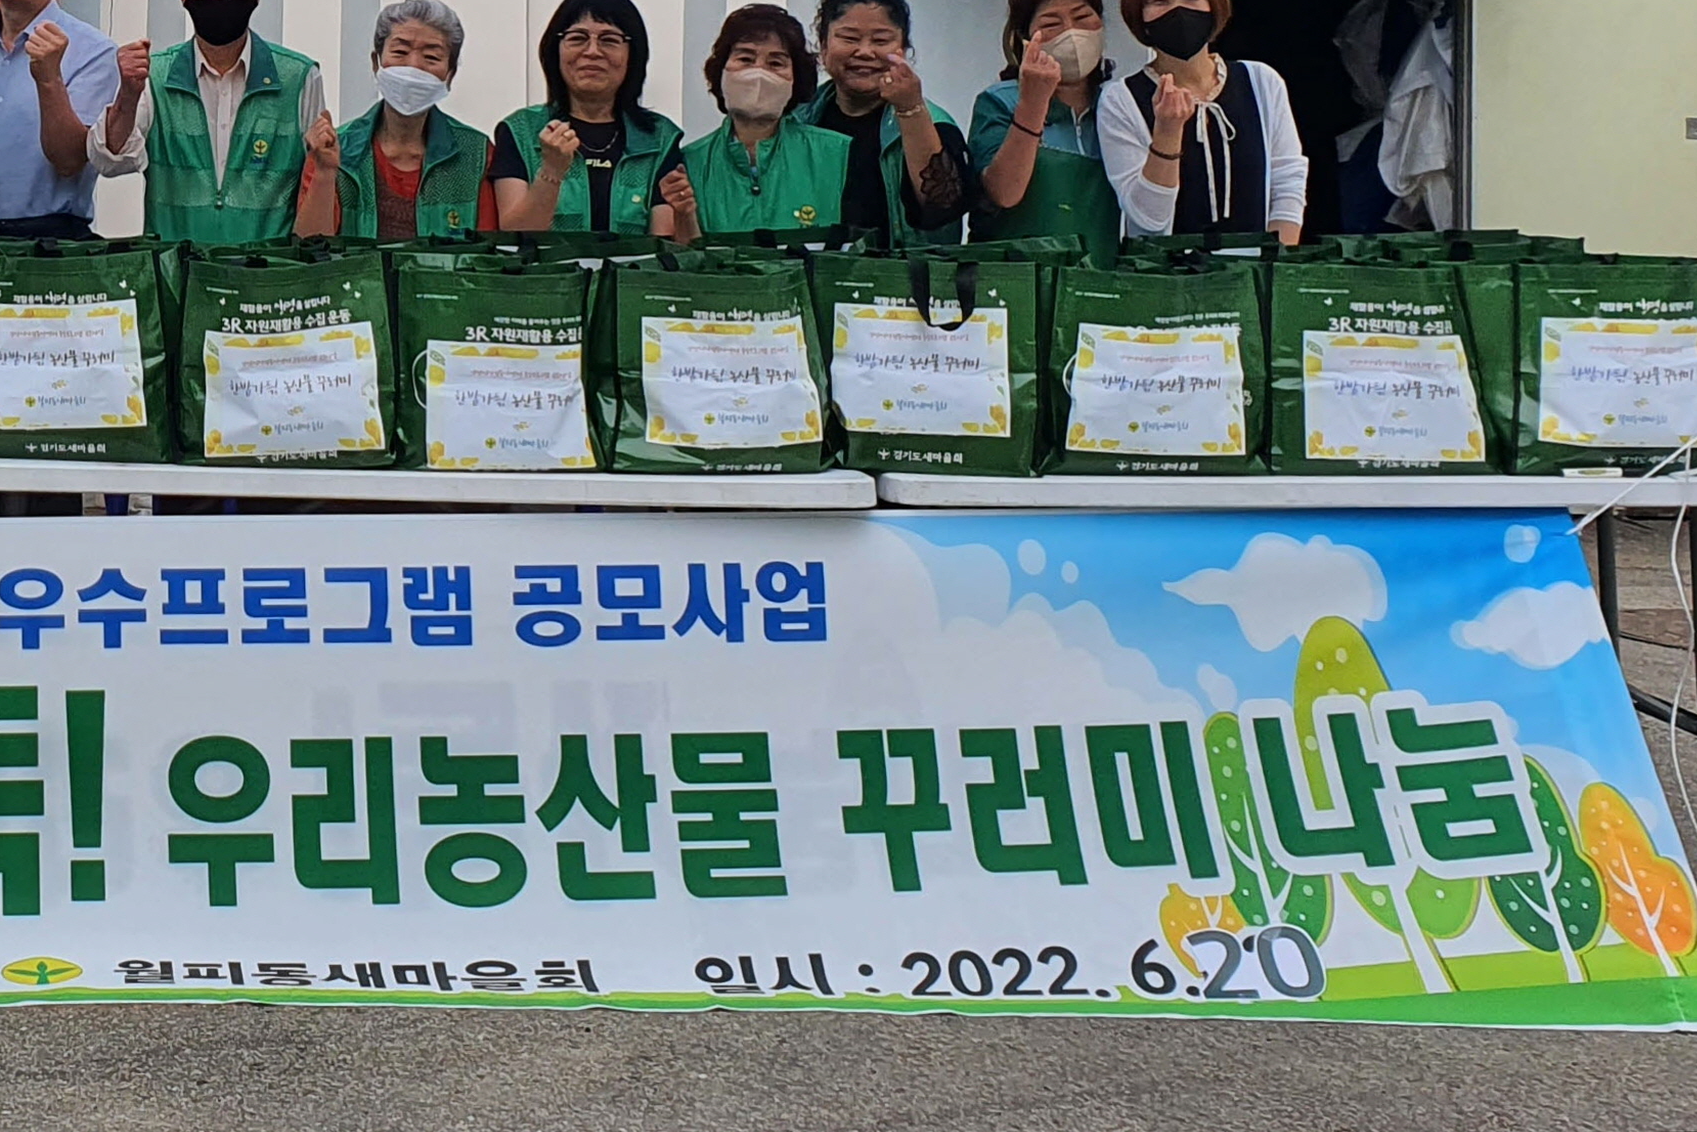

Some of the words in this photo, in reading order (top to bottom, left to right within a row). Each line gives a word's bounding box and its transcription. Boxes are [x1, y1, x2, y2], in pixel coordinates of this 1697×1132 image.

[585, 158, 612, 168] FILA
[221, 318, 244, 333] 3R
[245, 317, 302, 333] 자원재활용
[304, 313, 326, 328] 수집
[327, 309, 352, 324] 운동
[1328, 317, 1354, 332] 3R
[1355, 319, 1420, 334] 자원재활용
[465, 326, 490, 341] 3R
[491, 327, 553, 343] 자원재활용
[894, 450, 963, 464] 경기도새마을회
[512, 561, 827, 647] 공모사업
[168, 731, 788, 908] 우리농산물
[836, 720, 1220, 892] 꾸러미
[1252, 708, 1533, 867] 나눔
[113, 958, 601, 993] 월피동새마을회
[694, 953, 835, 996] 일시
